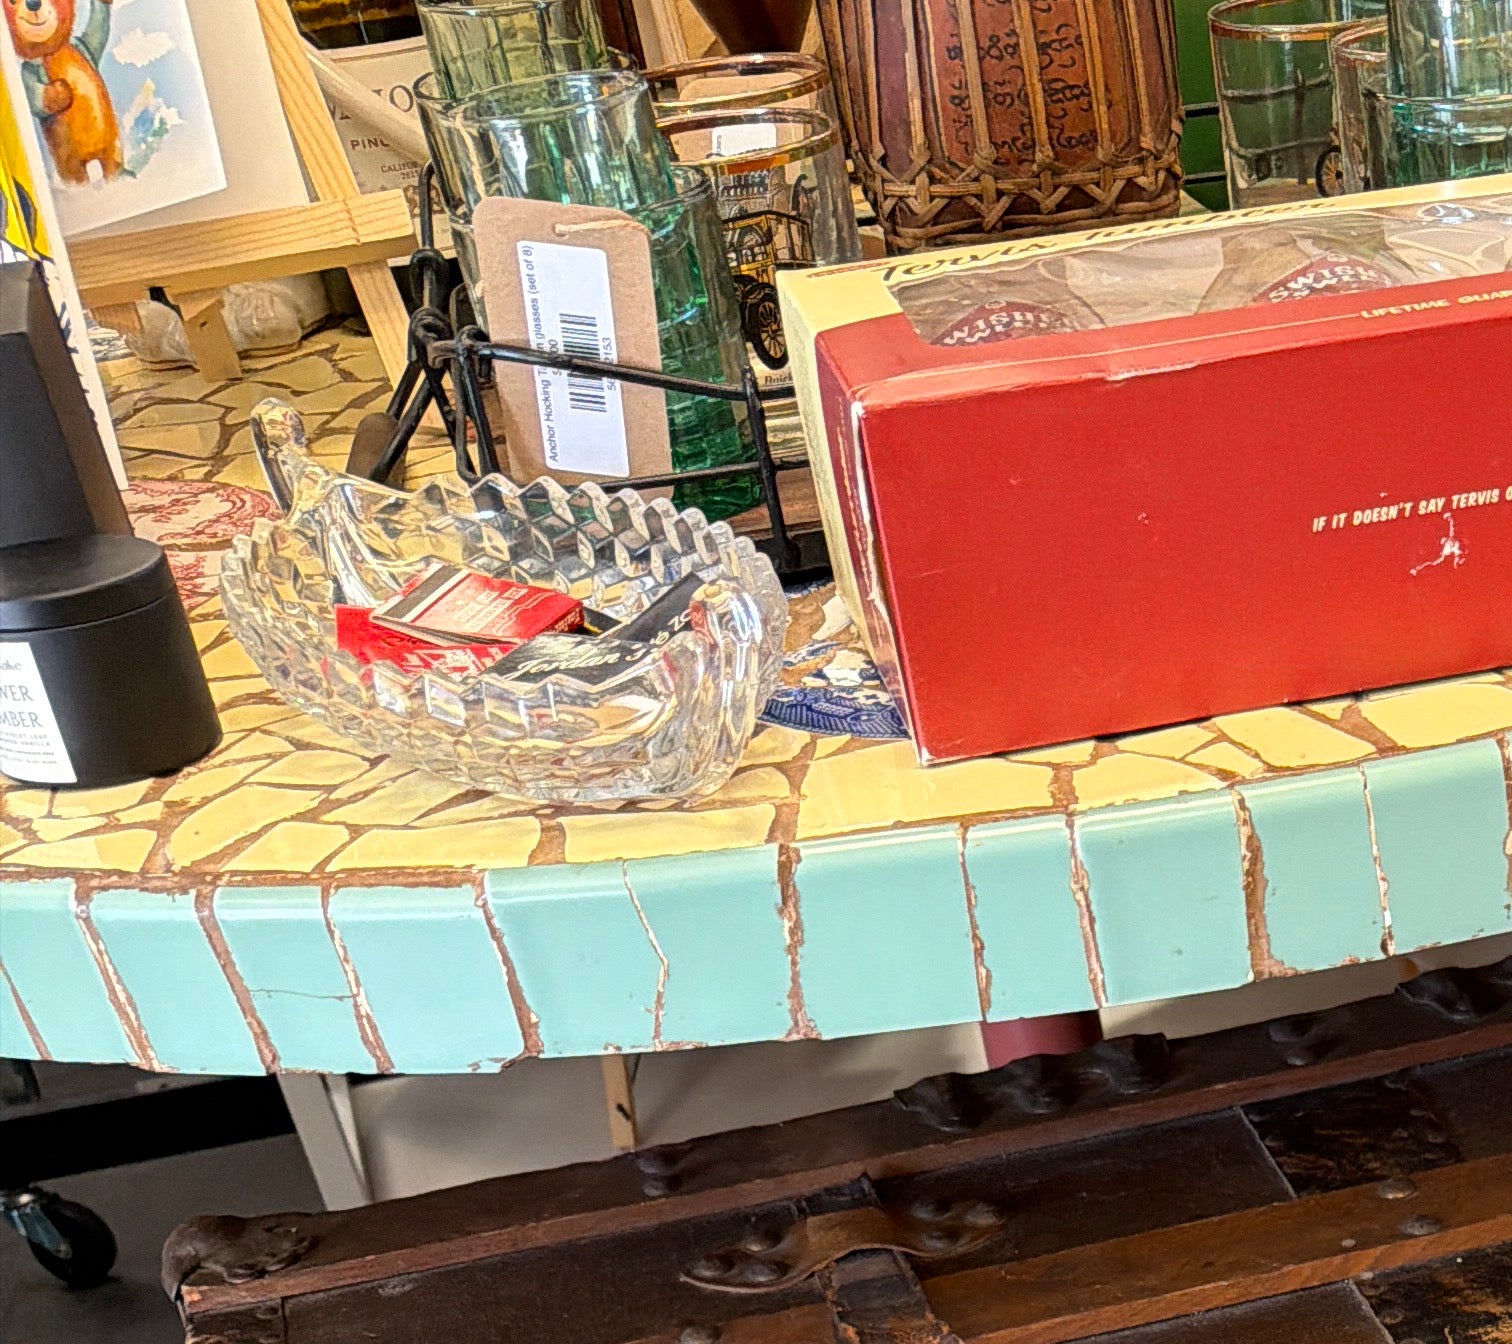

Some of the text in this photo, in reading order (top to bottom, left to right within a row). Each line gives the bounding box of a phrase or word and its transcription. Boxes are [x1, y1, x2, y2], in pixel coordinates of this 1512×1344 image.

[521, 245, 534, 257] 8)
[525, 258, 536, 271] of
[527, 272, 540, 295] (set
[530, 298, 546, 342] glasses
[1360, 299, 1450, 318] LIFETIME
[542, 378, 555, 422] Hocking
[547, 425, 560, 463] Anchor
[1312, 516, 1326, 532] IF
[1332, 513, 1347, 529] IT
[1353, 502, 1412, 526] DOESN'T
[1418, 497, 1446, 515] SAY
[1451, 489, 1500, 510] TERVIS
